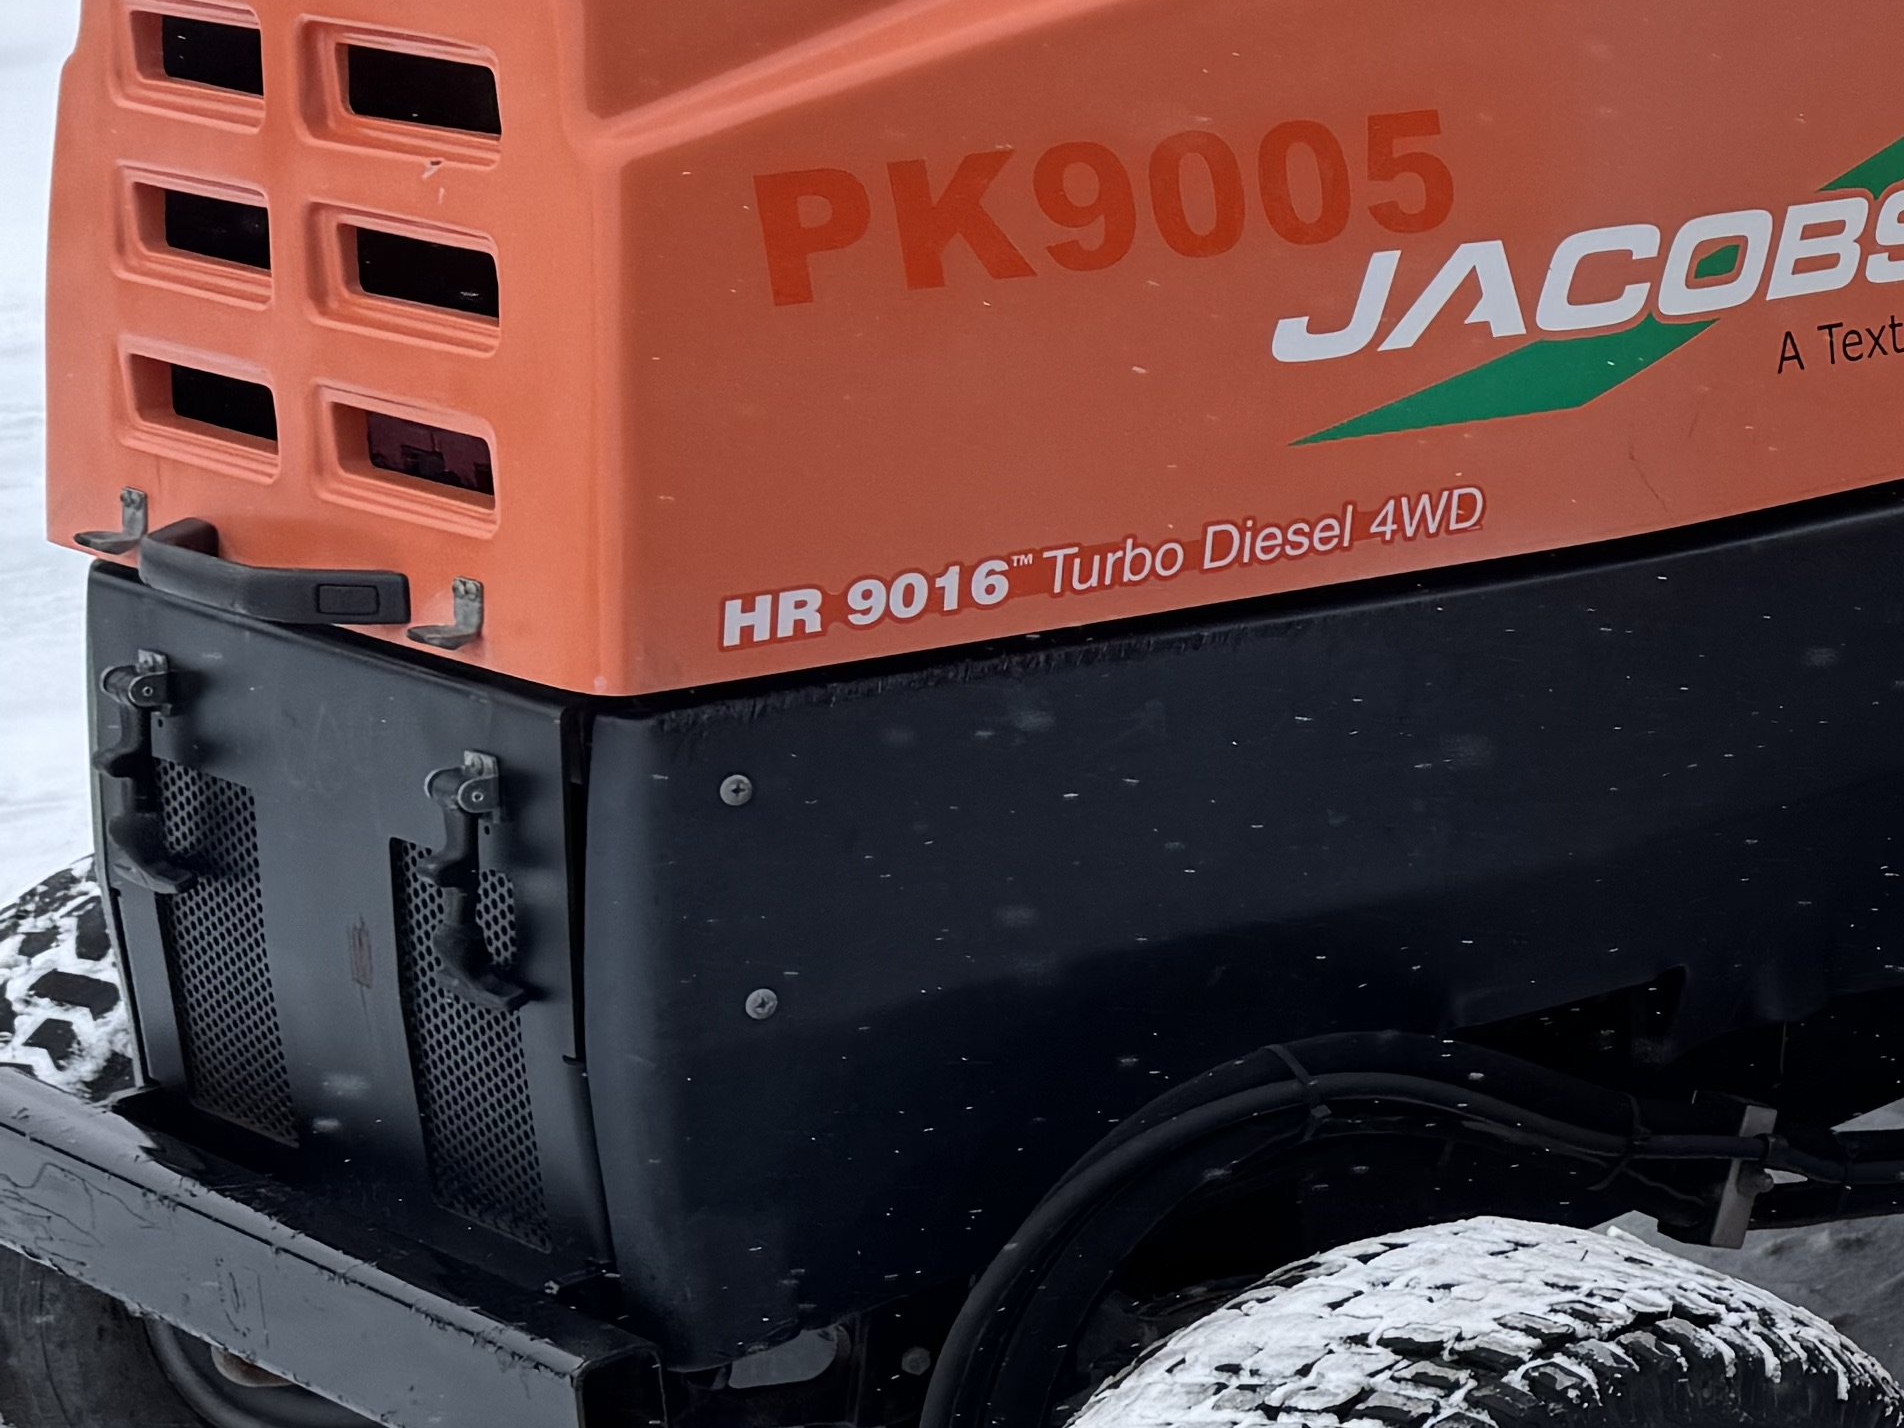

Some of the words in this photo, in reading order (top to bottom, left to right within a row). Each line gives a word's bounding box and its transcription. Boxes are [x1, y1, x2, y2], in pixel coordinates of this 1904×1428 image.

[753, 108, 1455, 307] PK9005
[1777, 330, 1805, 374] A
[723, 587, 823, 648] HR
[1042, 537, 1184, 594] Turbo
[1203, 503, 1354, 571] Diesel
[1369, 485, 1485, 542] 4WD
